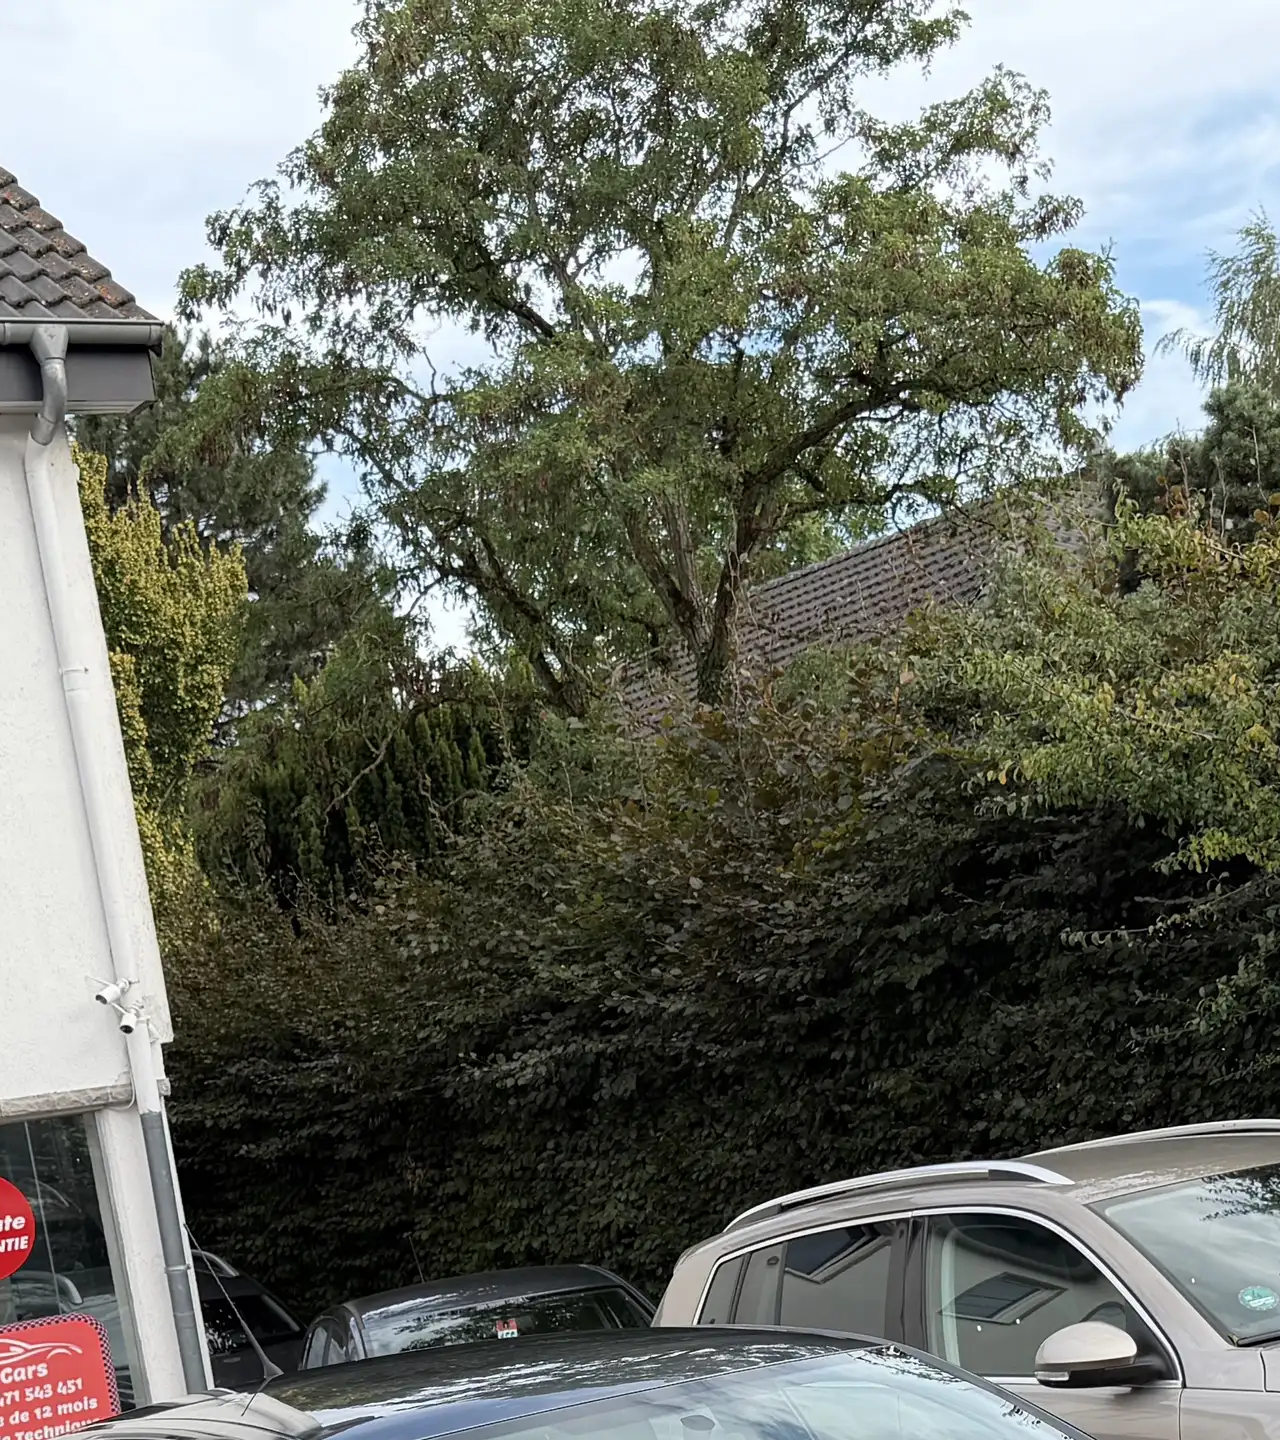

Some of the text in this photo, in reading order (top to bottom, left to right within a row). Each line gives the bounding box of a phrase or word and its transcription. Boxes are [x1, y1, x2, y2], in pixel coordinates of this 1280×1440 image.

[0, 1362, 49, 1384] Cars
[25, 1384, 53, 1402] 543
[57, 1378, 83, 1396] 451
[9, 1410, 30, 1424] de
[34, 1406, 53, 1420] 12
[57, 1396, 98, 1416] mois
